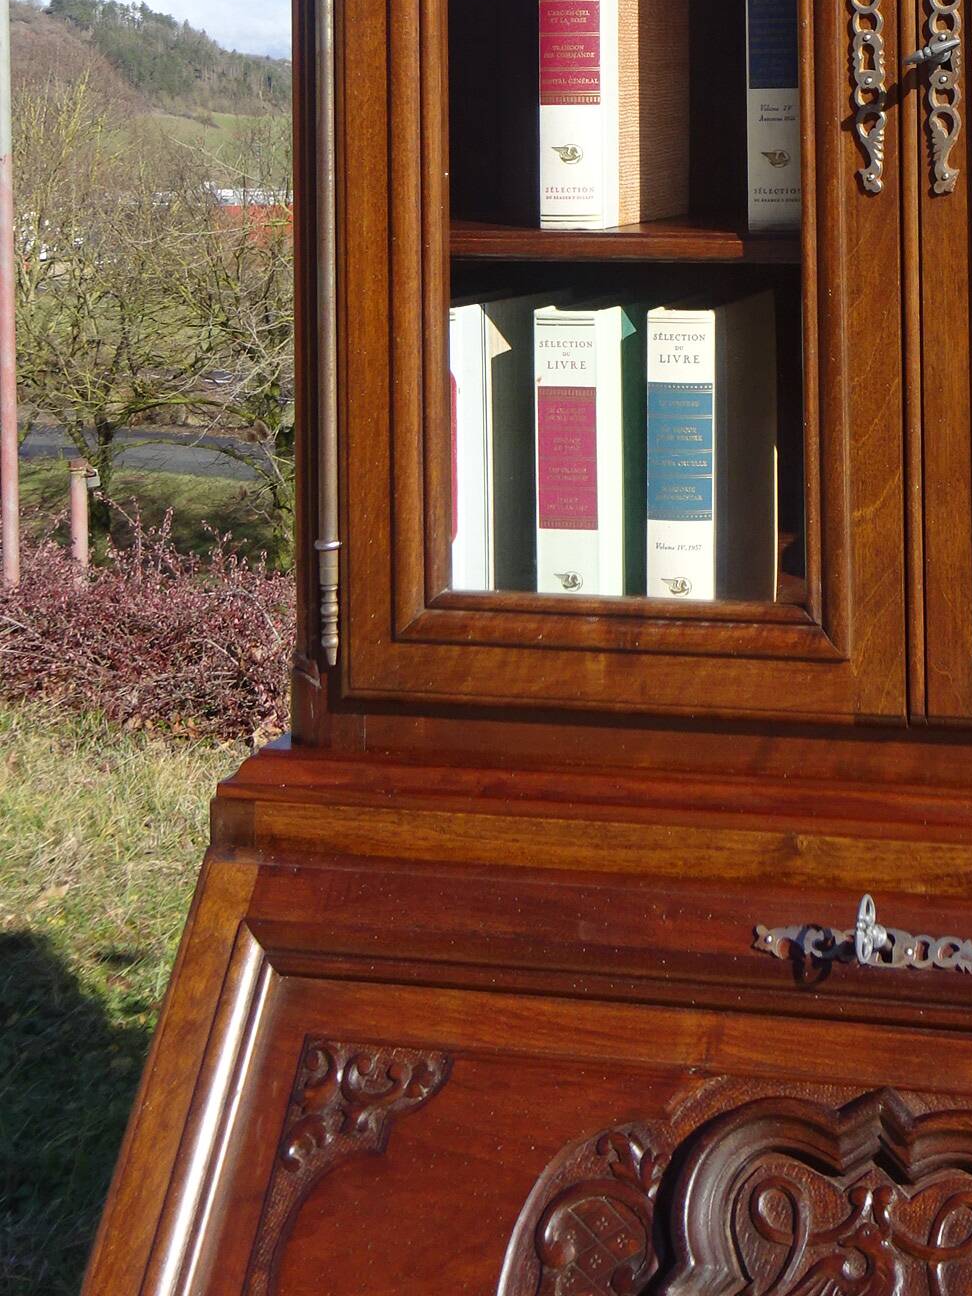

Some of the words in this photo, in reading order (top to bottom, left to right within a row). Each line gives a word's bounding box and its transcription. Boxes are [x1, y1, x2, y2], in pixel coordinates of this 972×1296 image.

[652, 331, 706, 342] SÉLECTION
[538, 339, 593, 349] SÉLECTION
[659, 353, 700, 365] LIVRE
[547, 359, 587, 371] LIVRE
[655, 541, 675, 551] Volume
